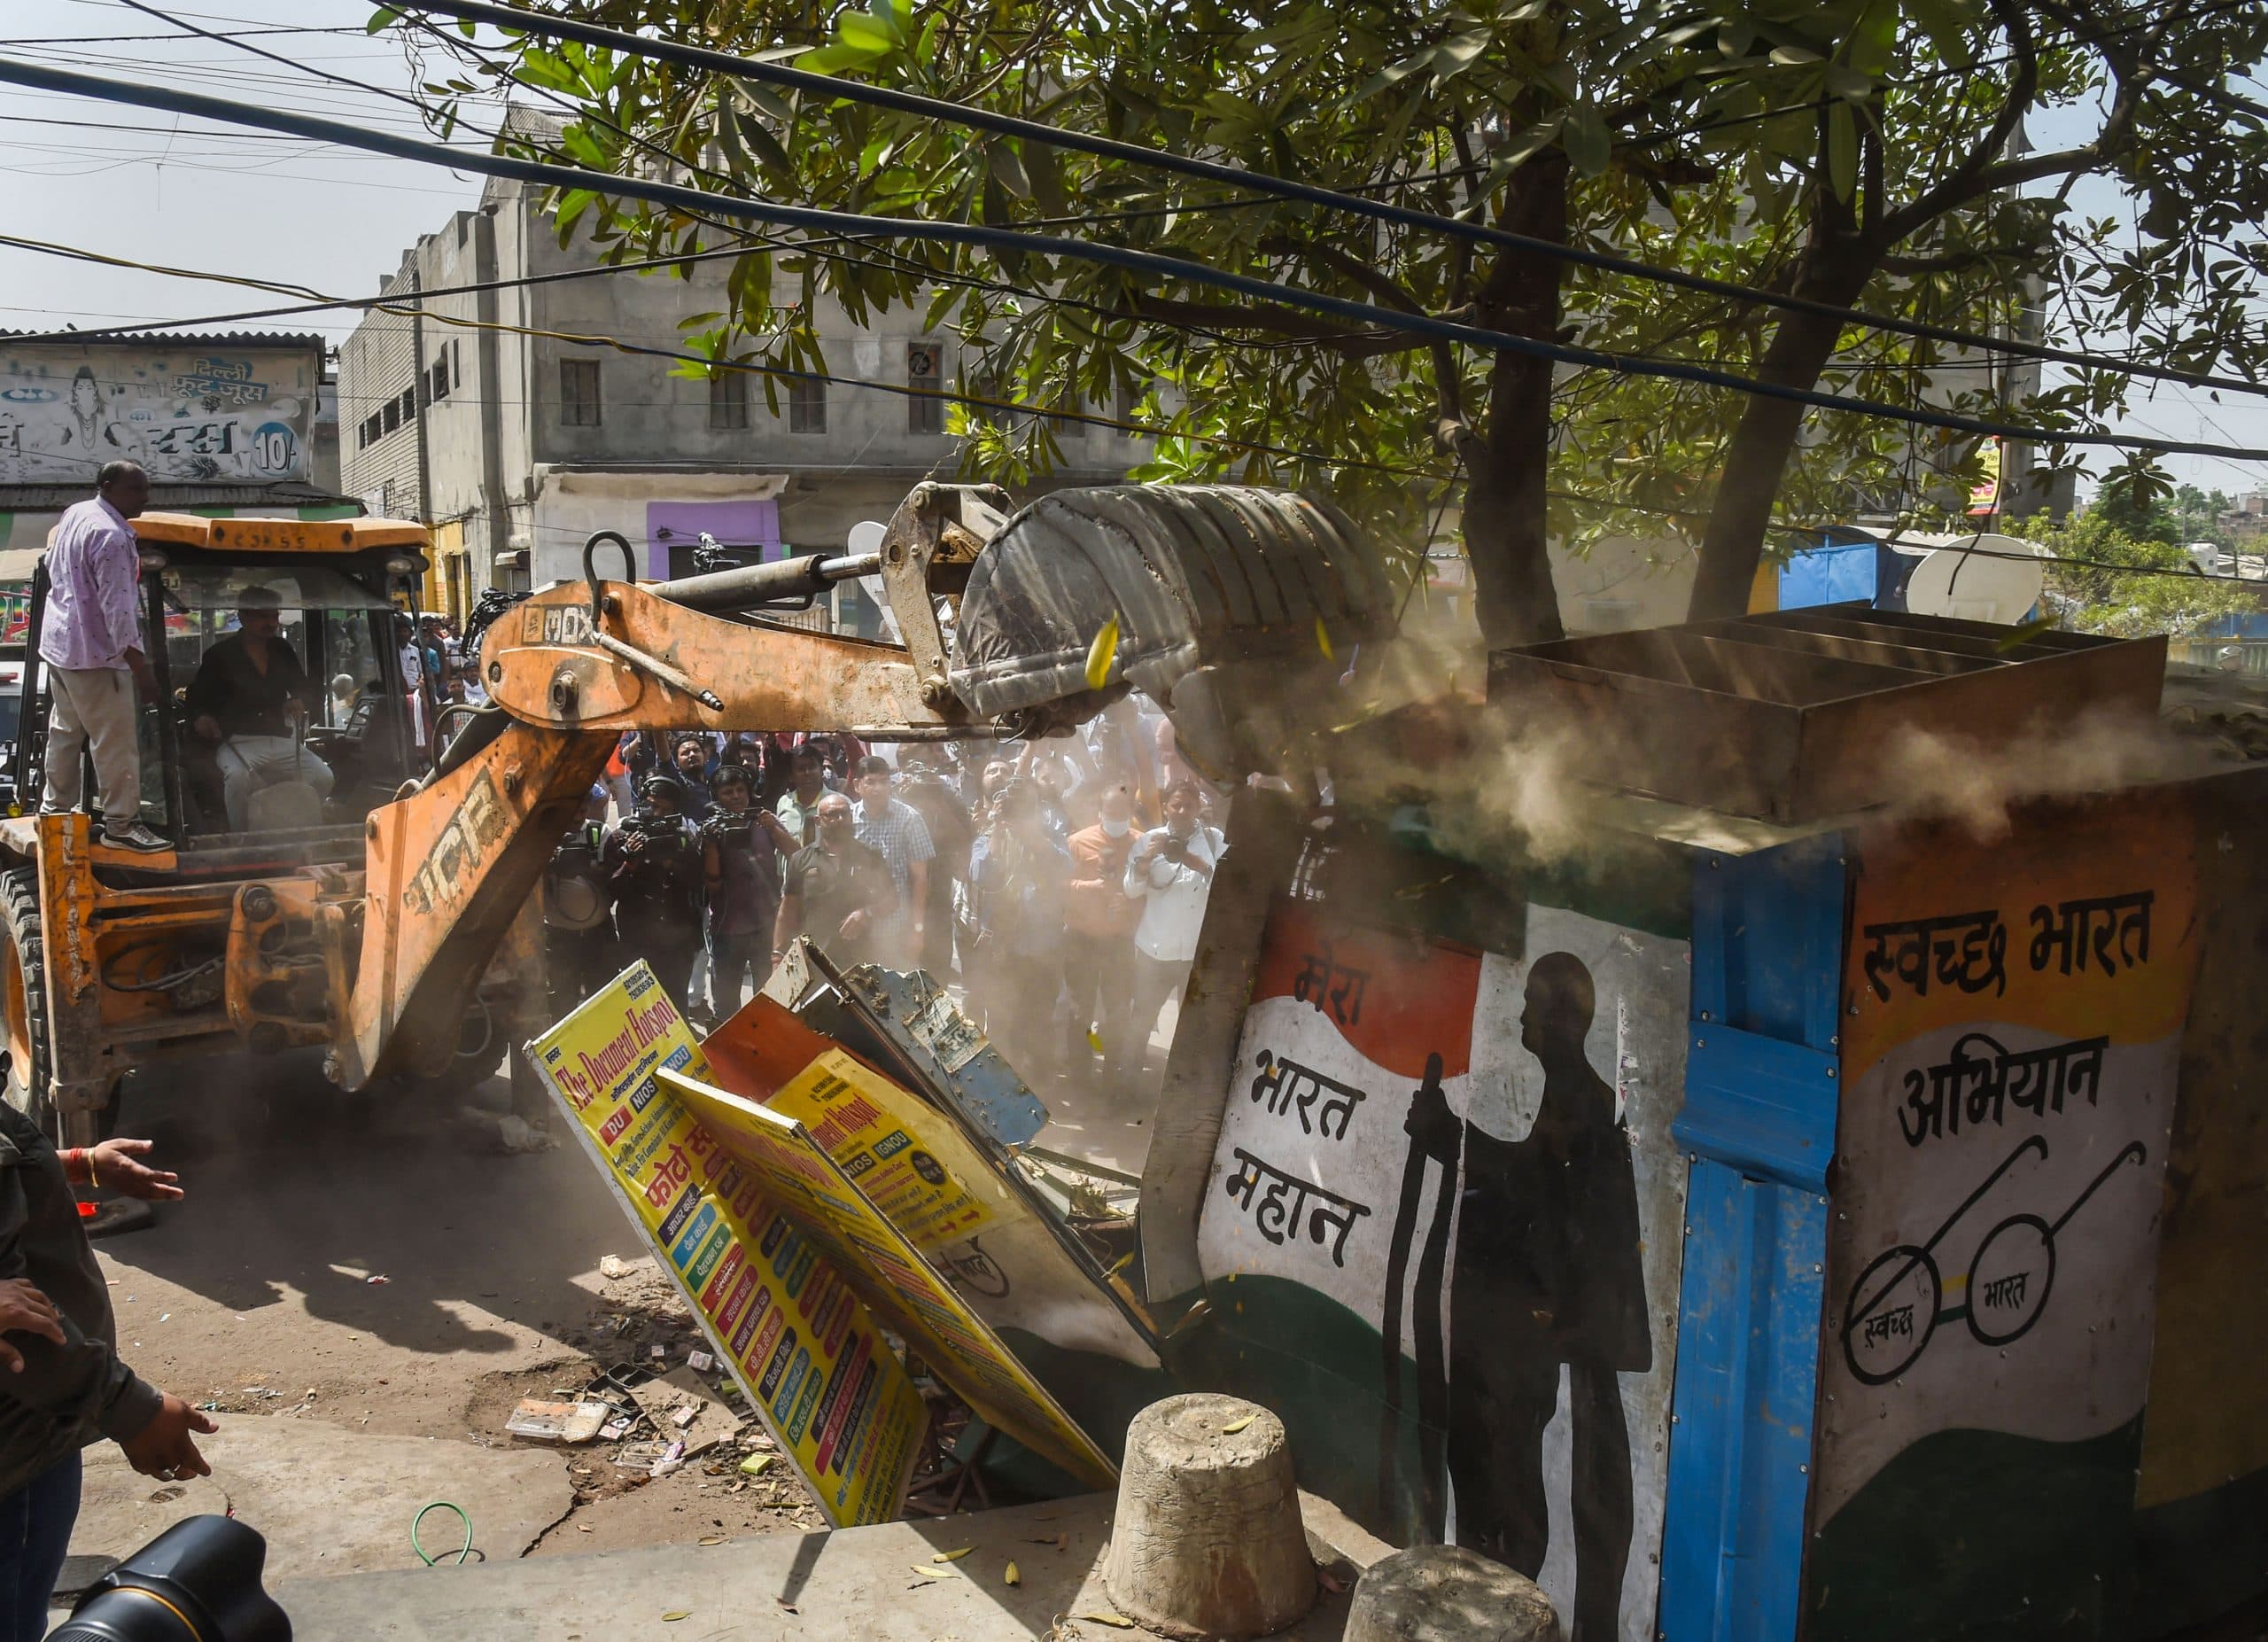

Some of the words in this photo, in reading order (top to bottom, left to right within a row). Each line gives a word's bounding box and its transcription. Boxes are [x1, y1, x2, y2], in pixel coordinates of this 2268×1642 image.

[193, 358, 248, 381] दिल्ली
[218, 380, 267, 405] जूस
[254, 430, 297, 471] 10/-
[1863, 910, 2007, 1003] स्वच्छ
[2029, 890, 2154, 977] भारत
[555, 1065, 594, 1111] The
[579, 1025, 635, 1093] Document
[625, 995, 679, 1050] Hotspot
[608, 1116, 625, 1136] DU
[632, 1080, 656, 1109] NIOS
[1250, 1048, 1366, 1141] भारत
[1898, 1032, 2109, 1147] अभियान
[826, 1093, 882, 1135] Hotspot
[646, 1144, 691, 1208] फोटो
[843, 1156, 874, 1177] NIOS
[875, 1132, 906, 1156] IGNOU
[667, 1210, 685, 1235] आधार
[681, 1192, 695, 1213] कार्ड
[694, 1216, 706, 1238] कार्ड
[1226, 1147, 1371, 1268] महान
[726, 1296, 742, 1323] राशन
[739, 1275, 751, 1298] कार्ड
[1984, 1272, 2030, 1310] भारत
[1864, 1304, 1914, 1349] स्वच्छ
